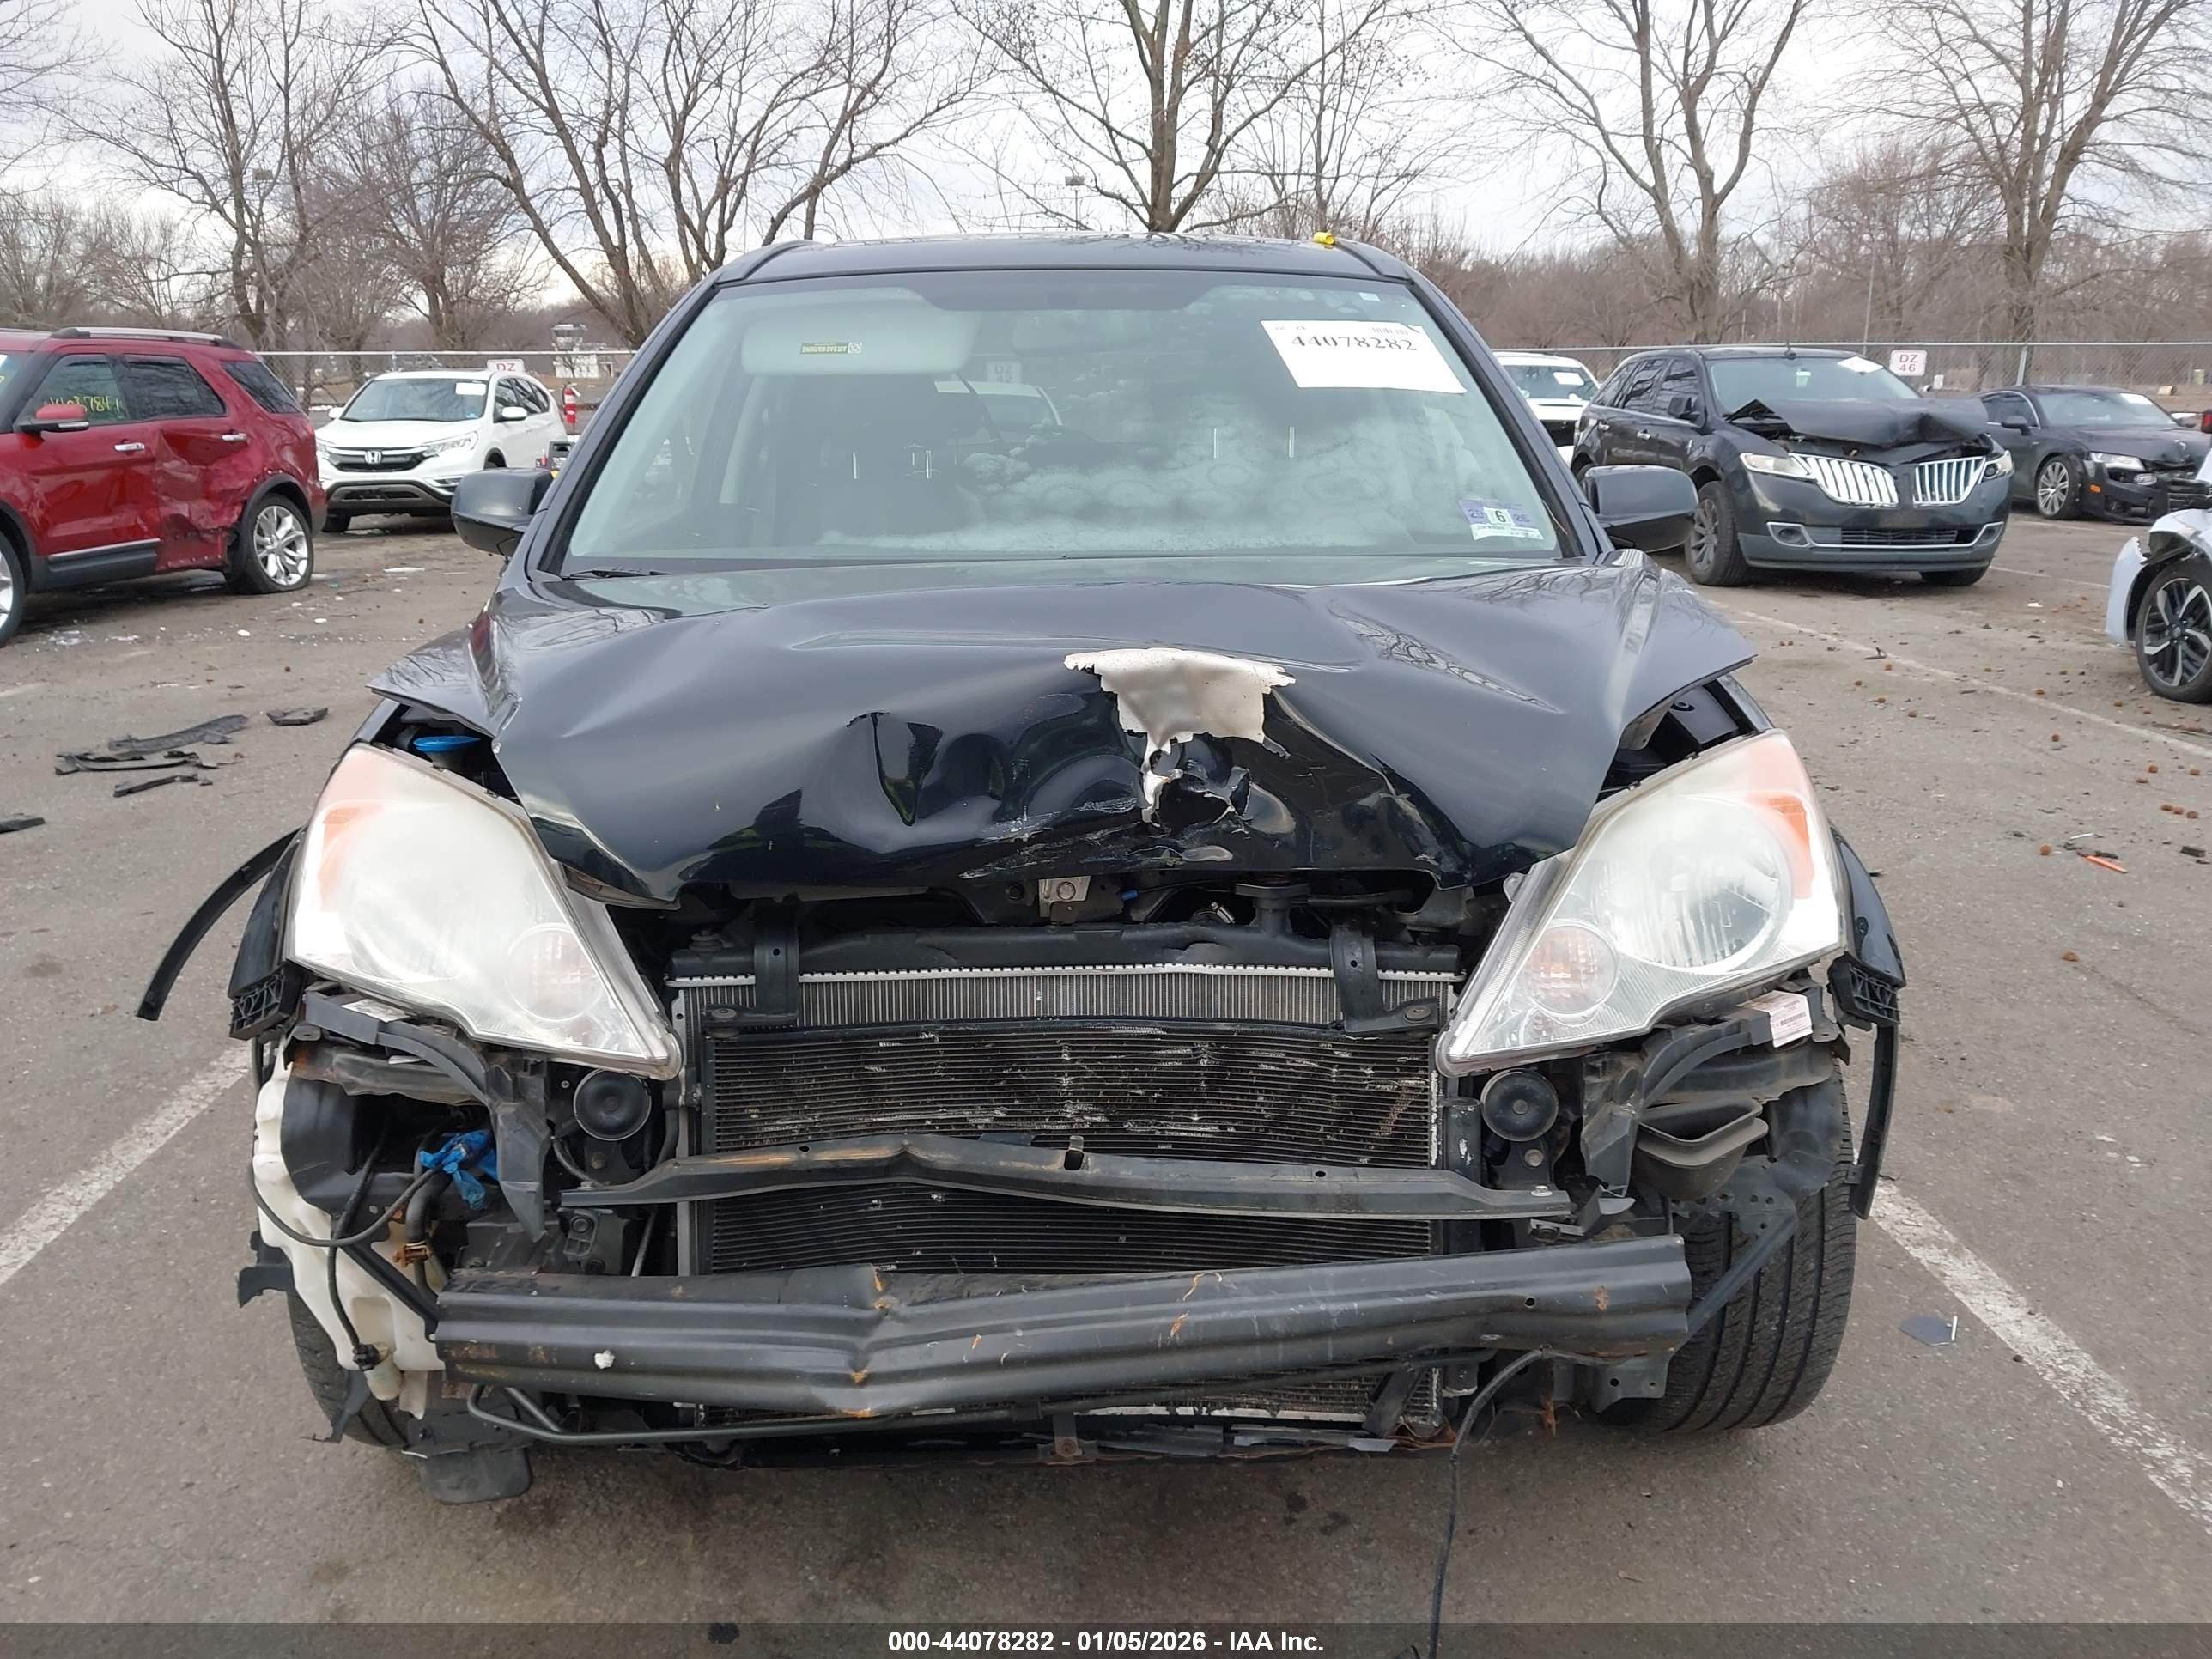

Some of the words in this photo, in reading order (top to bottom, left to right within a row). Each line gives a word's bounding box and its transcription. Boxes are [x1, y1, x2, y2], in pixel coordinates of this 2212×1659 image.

[1291, 335, 1417, 351] 44078282
[1899, 354, 1918, 363] DZ
[496, 362, 515, 371] DZ
[1899, 363, 1916, 372] 46
[1495, 510, 1506, 523] 6
